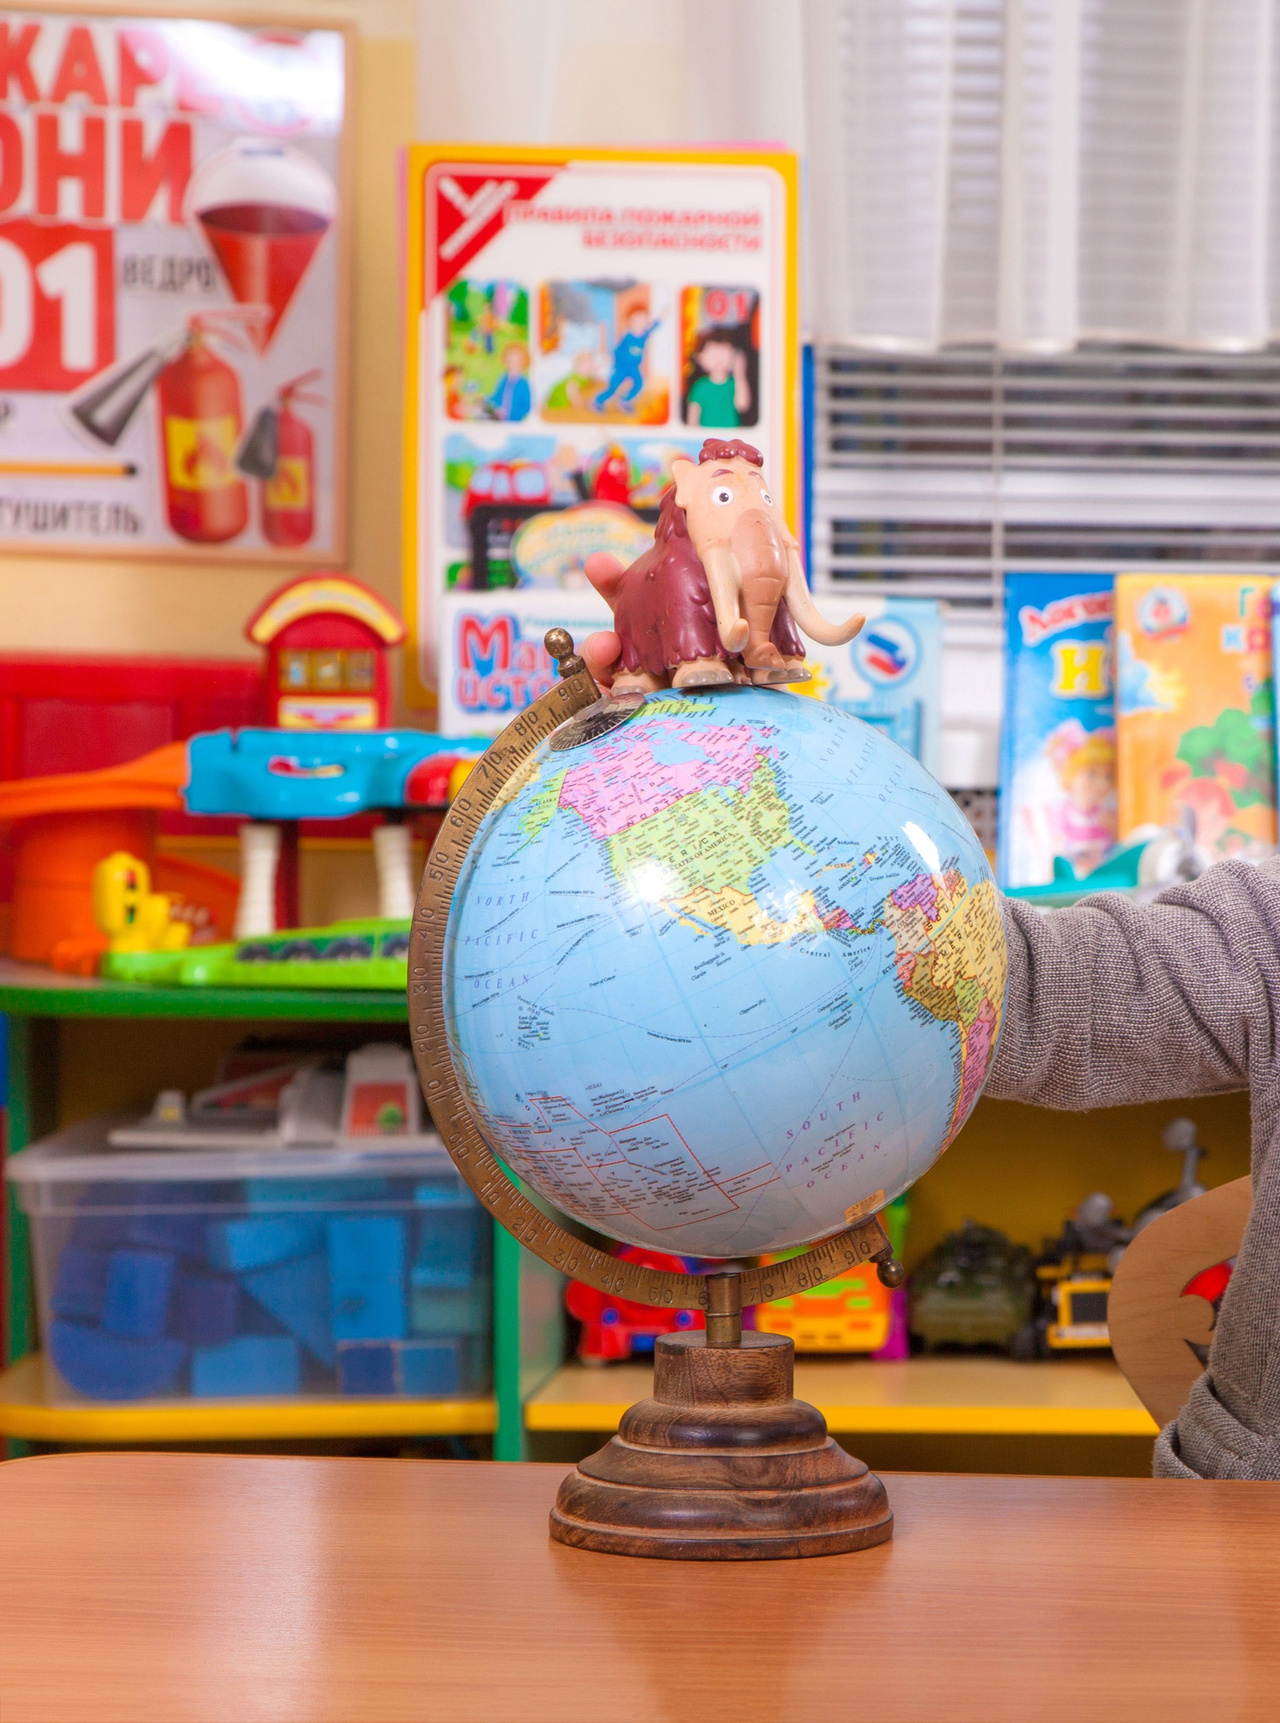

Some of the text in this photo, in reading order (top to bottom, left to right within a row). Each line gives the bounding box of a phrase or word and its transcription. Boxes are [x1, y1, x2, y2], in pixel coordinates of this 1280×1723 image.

[504, 204, 762, 227] ПРАВИЛА ПОЖАРНОЙ
[582, 228, 762, 249] БЕЗОПАСНОСТИ
[123, 254, 216, 292] ВЕДРО
[705, 290, 749, 320] 01
[0, 500, 140, 534] УШИТЕЛЬ
[707, 899, 736, 917] MEXICO
[464, 928, 538, 947] PACIFIC
[842, 946, 871, 958] America
[473, 974, 530, 990] OCEAN
[786, 1091, 860, 1139] SOUTH
[786, 1112, 884, 1173] PACIFIC
[806, 1143, 881, 1188] OCEAN
